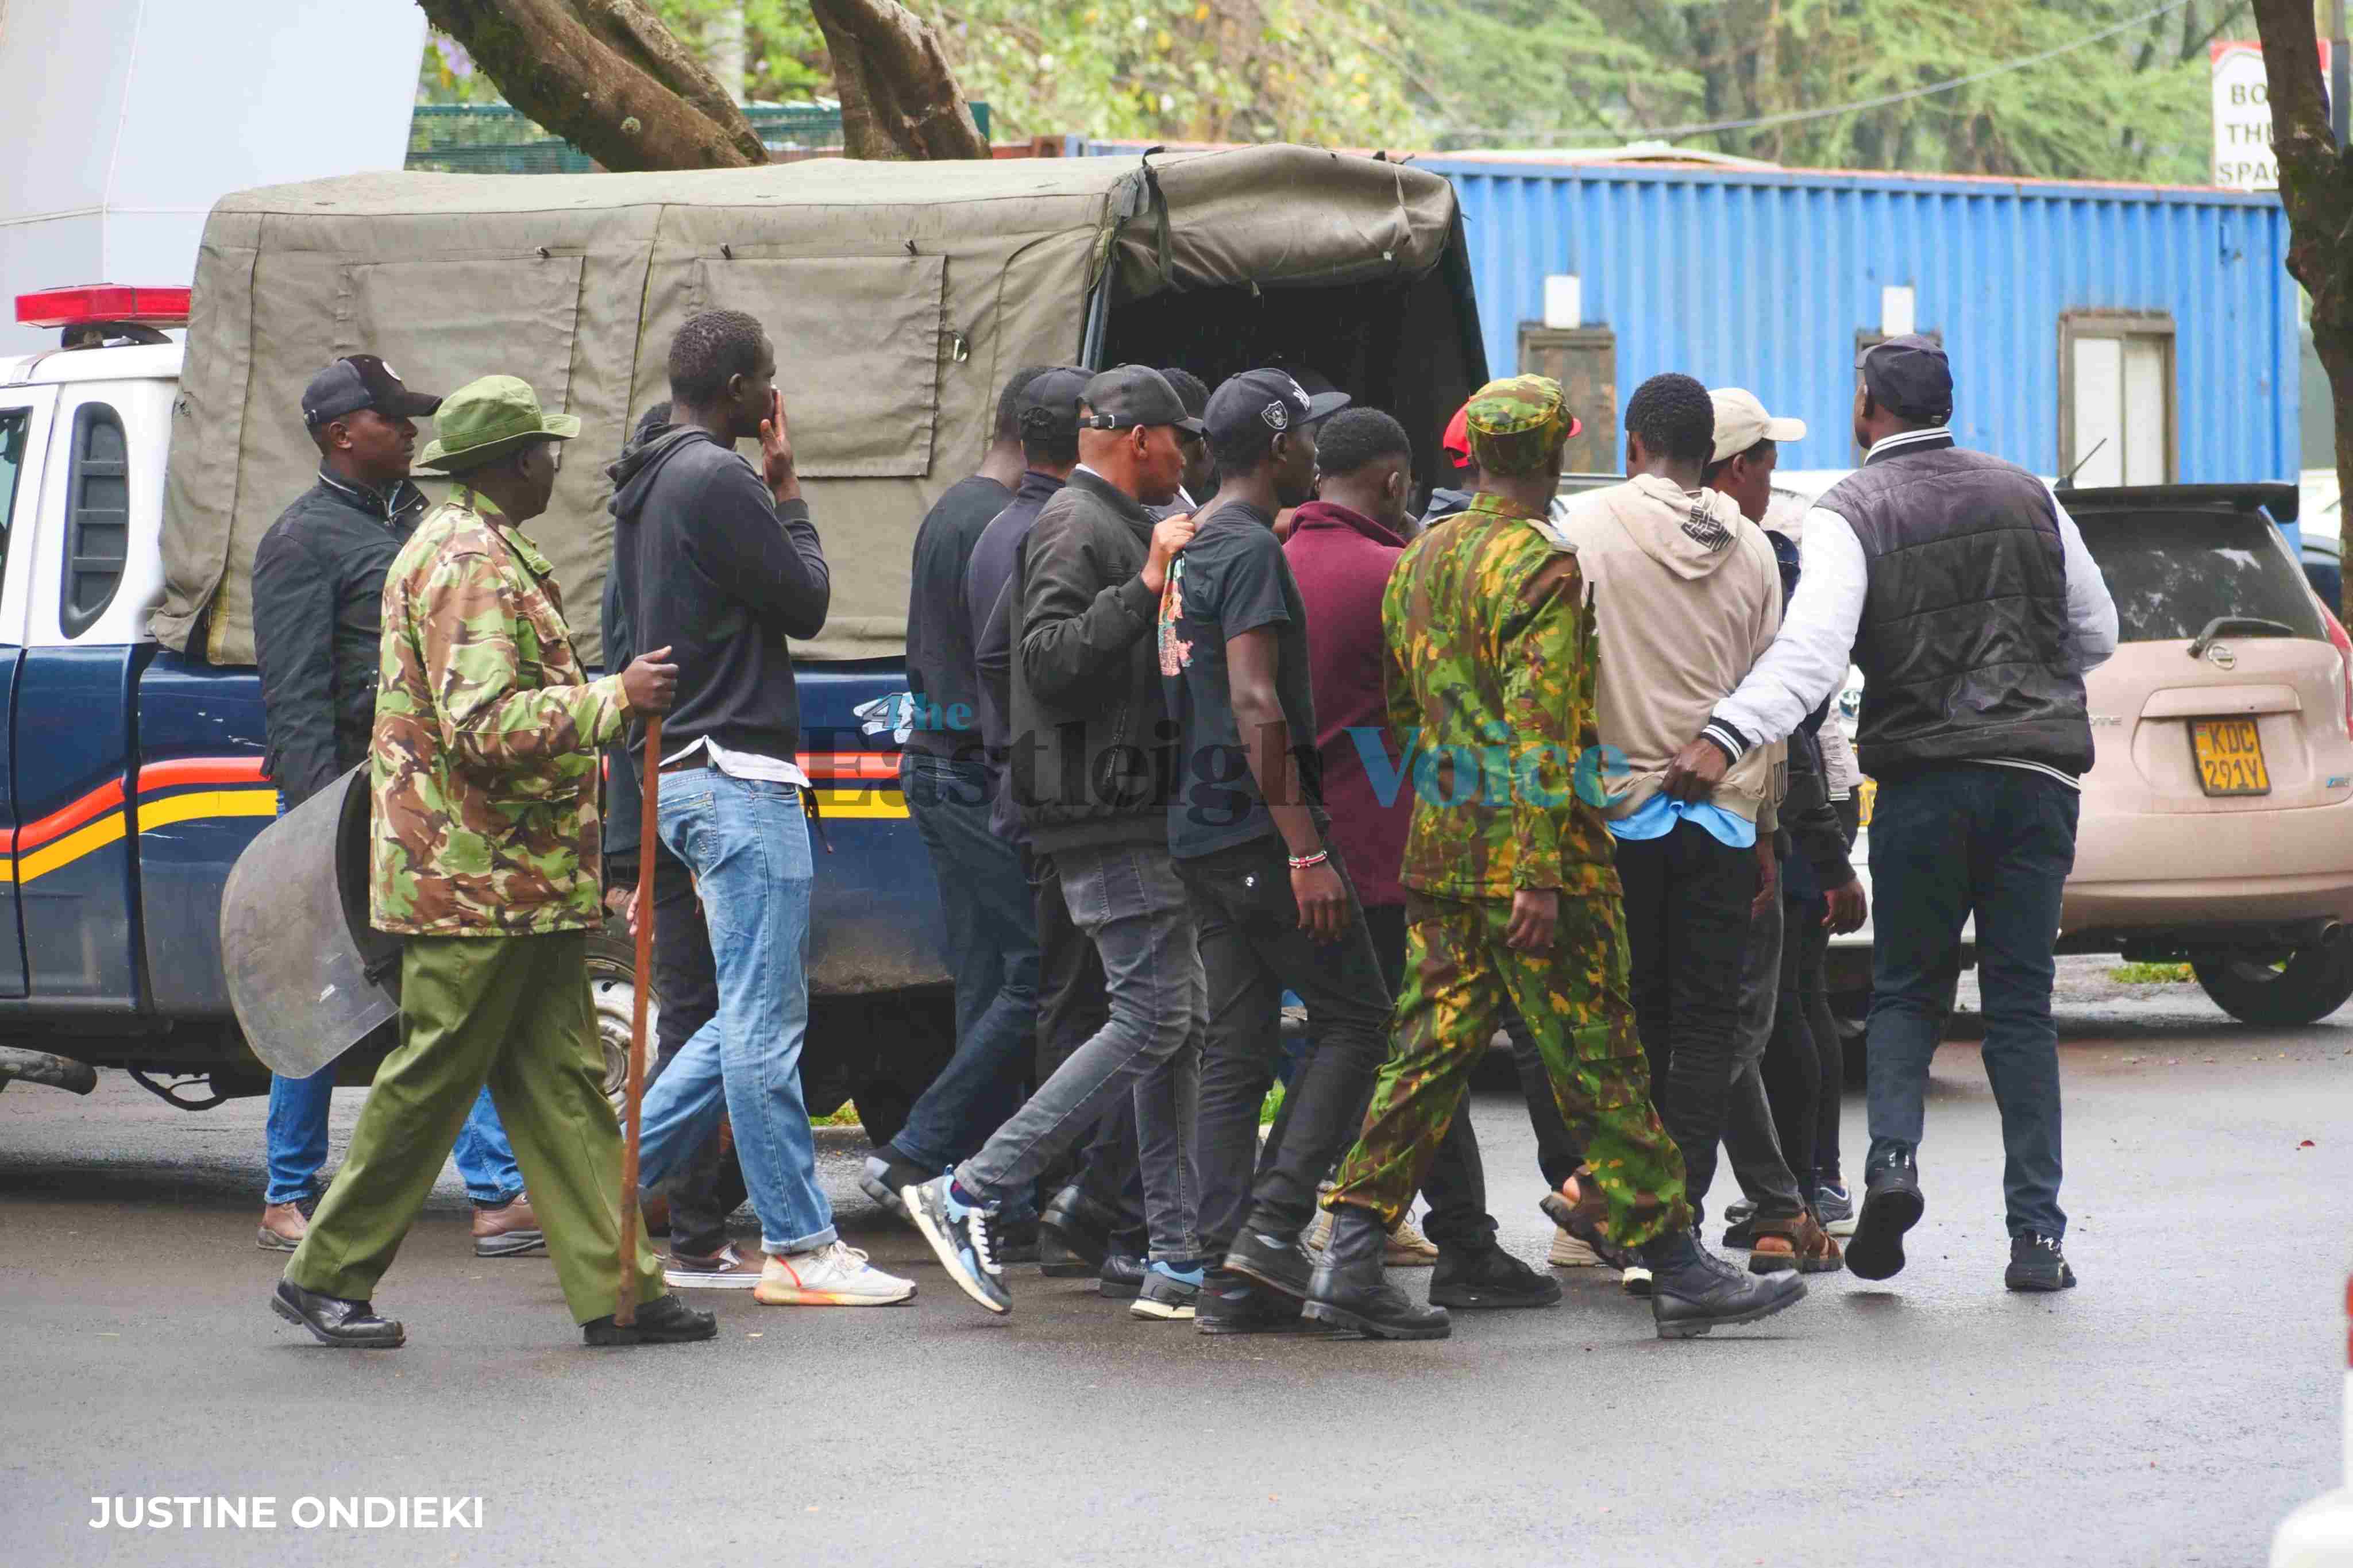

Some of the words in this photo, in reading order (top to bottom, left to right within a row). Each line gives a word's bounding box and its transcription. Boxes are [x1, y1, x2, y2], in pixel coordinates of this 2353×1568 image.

[2231, 84, 2268, 105] BO
[2226, 123, 2271, 144] THI
[861, 692, 913, 729] 4
[2208, 723, 2254, 754] KDC
